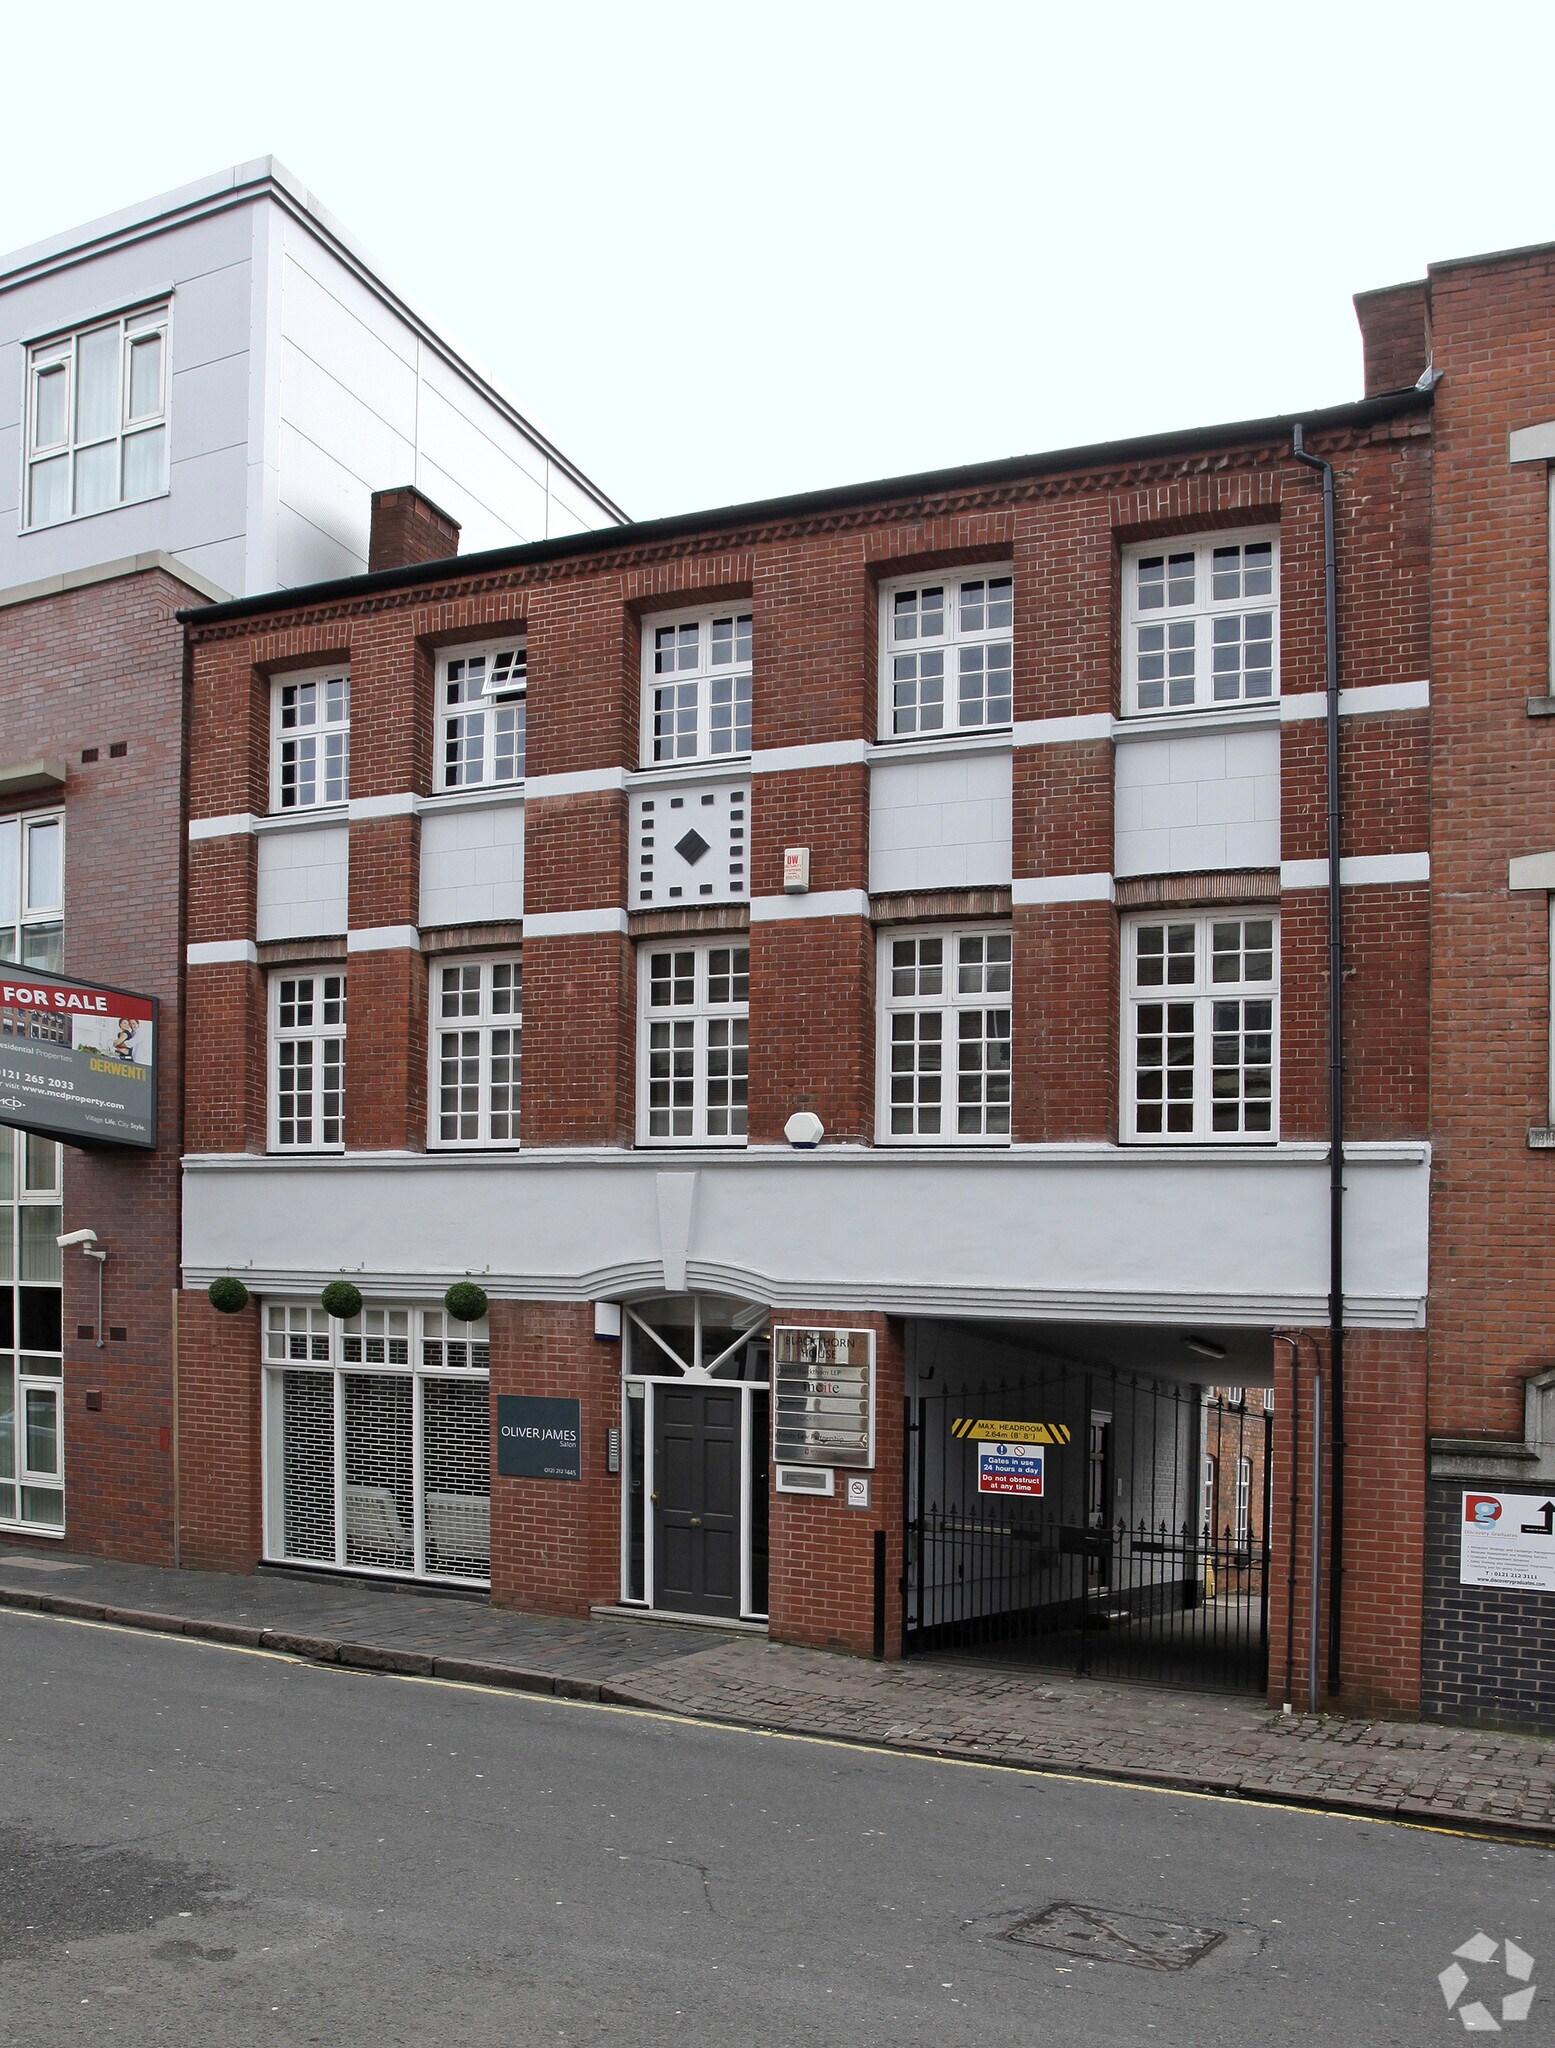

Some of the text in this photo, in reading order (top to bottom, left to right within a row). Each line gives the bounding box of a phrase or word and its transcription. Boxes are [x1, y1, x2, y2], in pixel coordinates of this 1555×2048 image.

[3, 986, 108, 1012] FOR SALE
[35, 1048, 73, 1063] Properties
[0, 1068, 74, 1091] 121 265 2033
[4, 1081, 20, 1090] visit
[21, 1084, 125, 1110] www.mcdproperty.com
[84, 1114, 104, 1124] Village
[785, 1335, 856, 1349] BLACKTHORN
[801, 1346, 837, 1359] HOUSE
[501, 1425, 577, 1441] OLIVER JAMES
[999, 1424, 1043, 1432] HEADROOM
[985, 1430, 1008, 1438] 2.64m
[560, 1440, 577, 1448] Salon
[1011, 1458, 1019, 1466] in
[1025, 1467, 1039, 1475] day
[1009, 1476, 1040, 1485] obstruct
[1477, 1577, 1546, 1587] www.discoverygraduates.com
